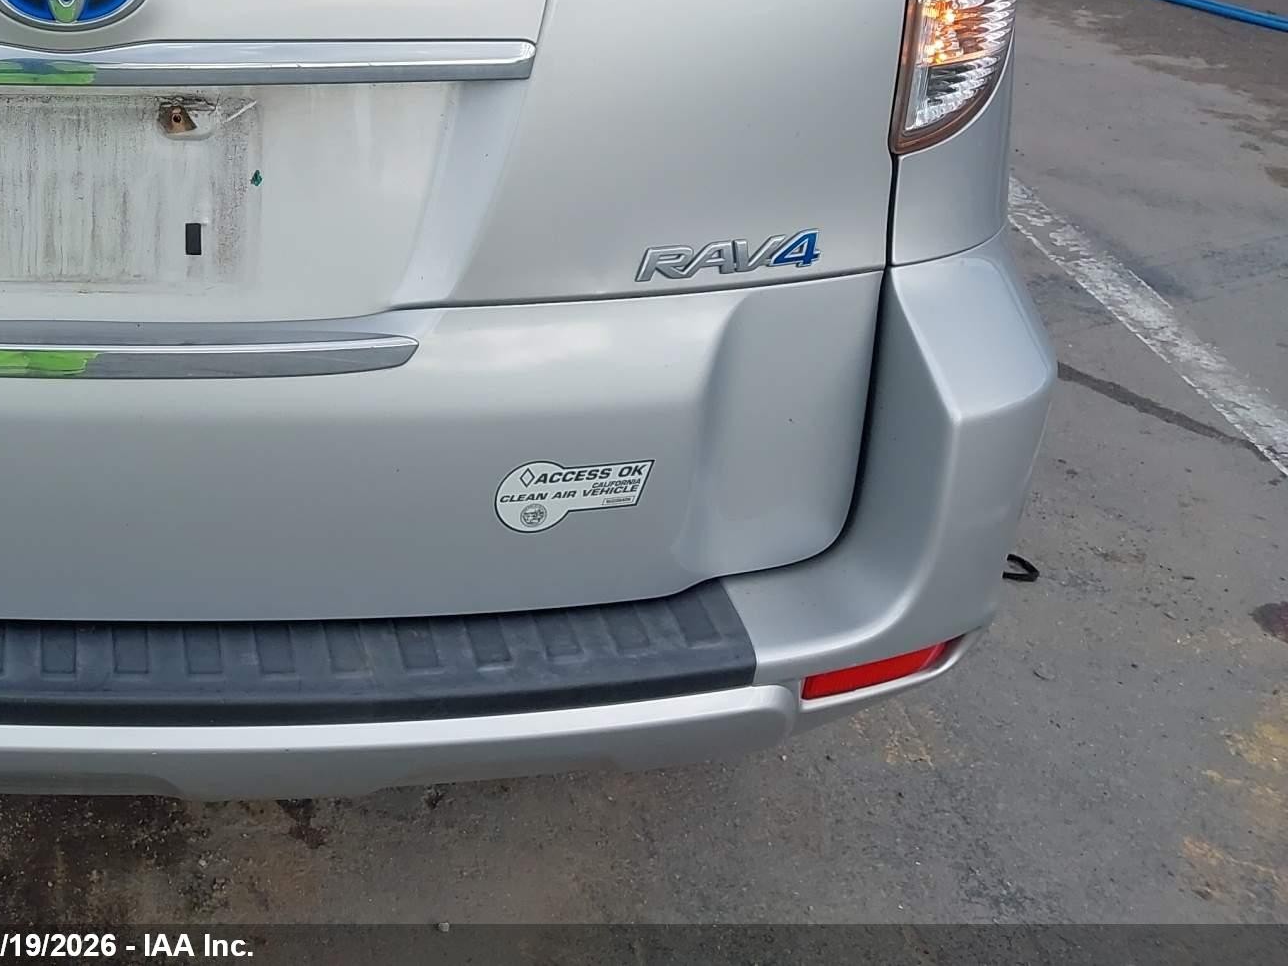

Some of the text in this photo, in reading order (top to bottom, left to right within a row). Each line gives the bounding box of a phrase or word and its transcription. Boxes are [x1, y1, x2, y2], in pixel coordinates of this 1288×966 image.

[634, 228, 821, 282] RAV4
[534, 464, 648, 485] ACCESS OK
[592, 478, 641, 489] CALIFORNIA
[500, 484, 640, 503] CLEAN AIR VEHICLE
